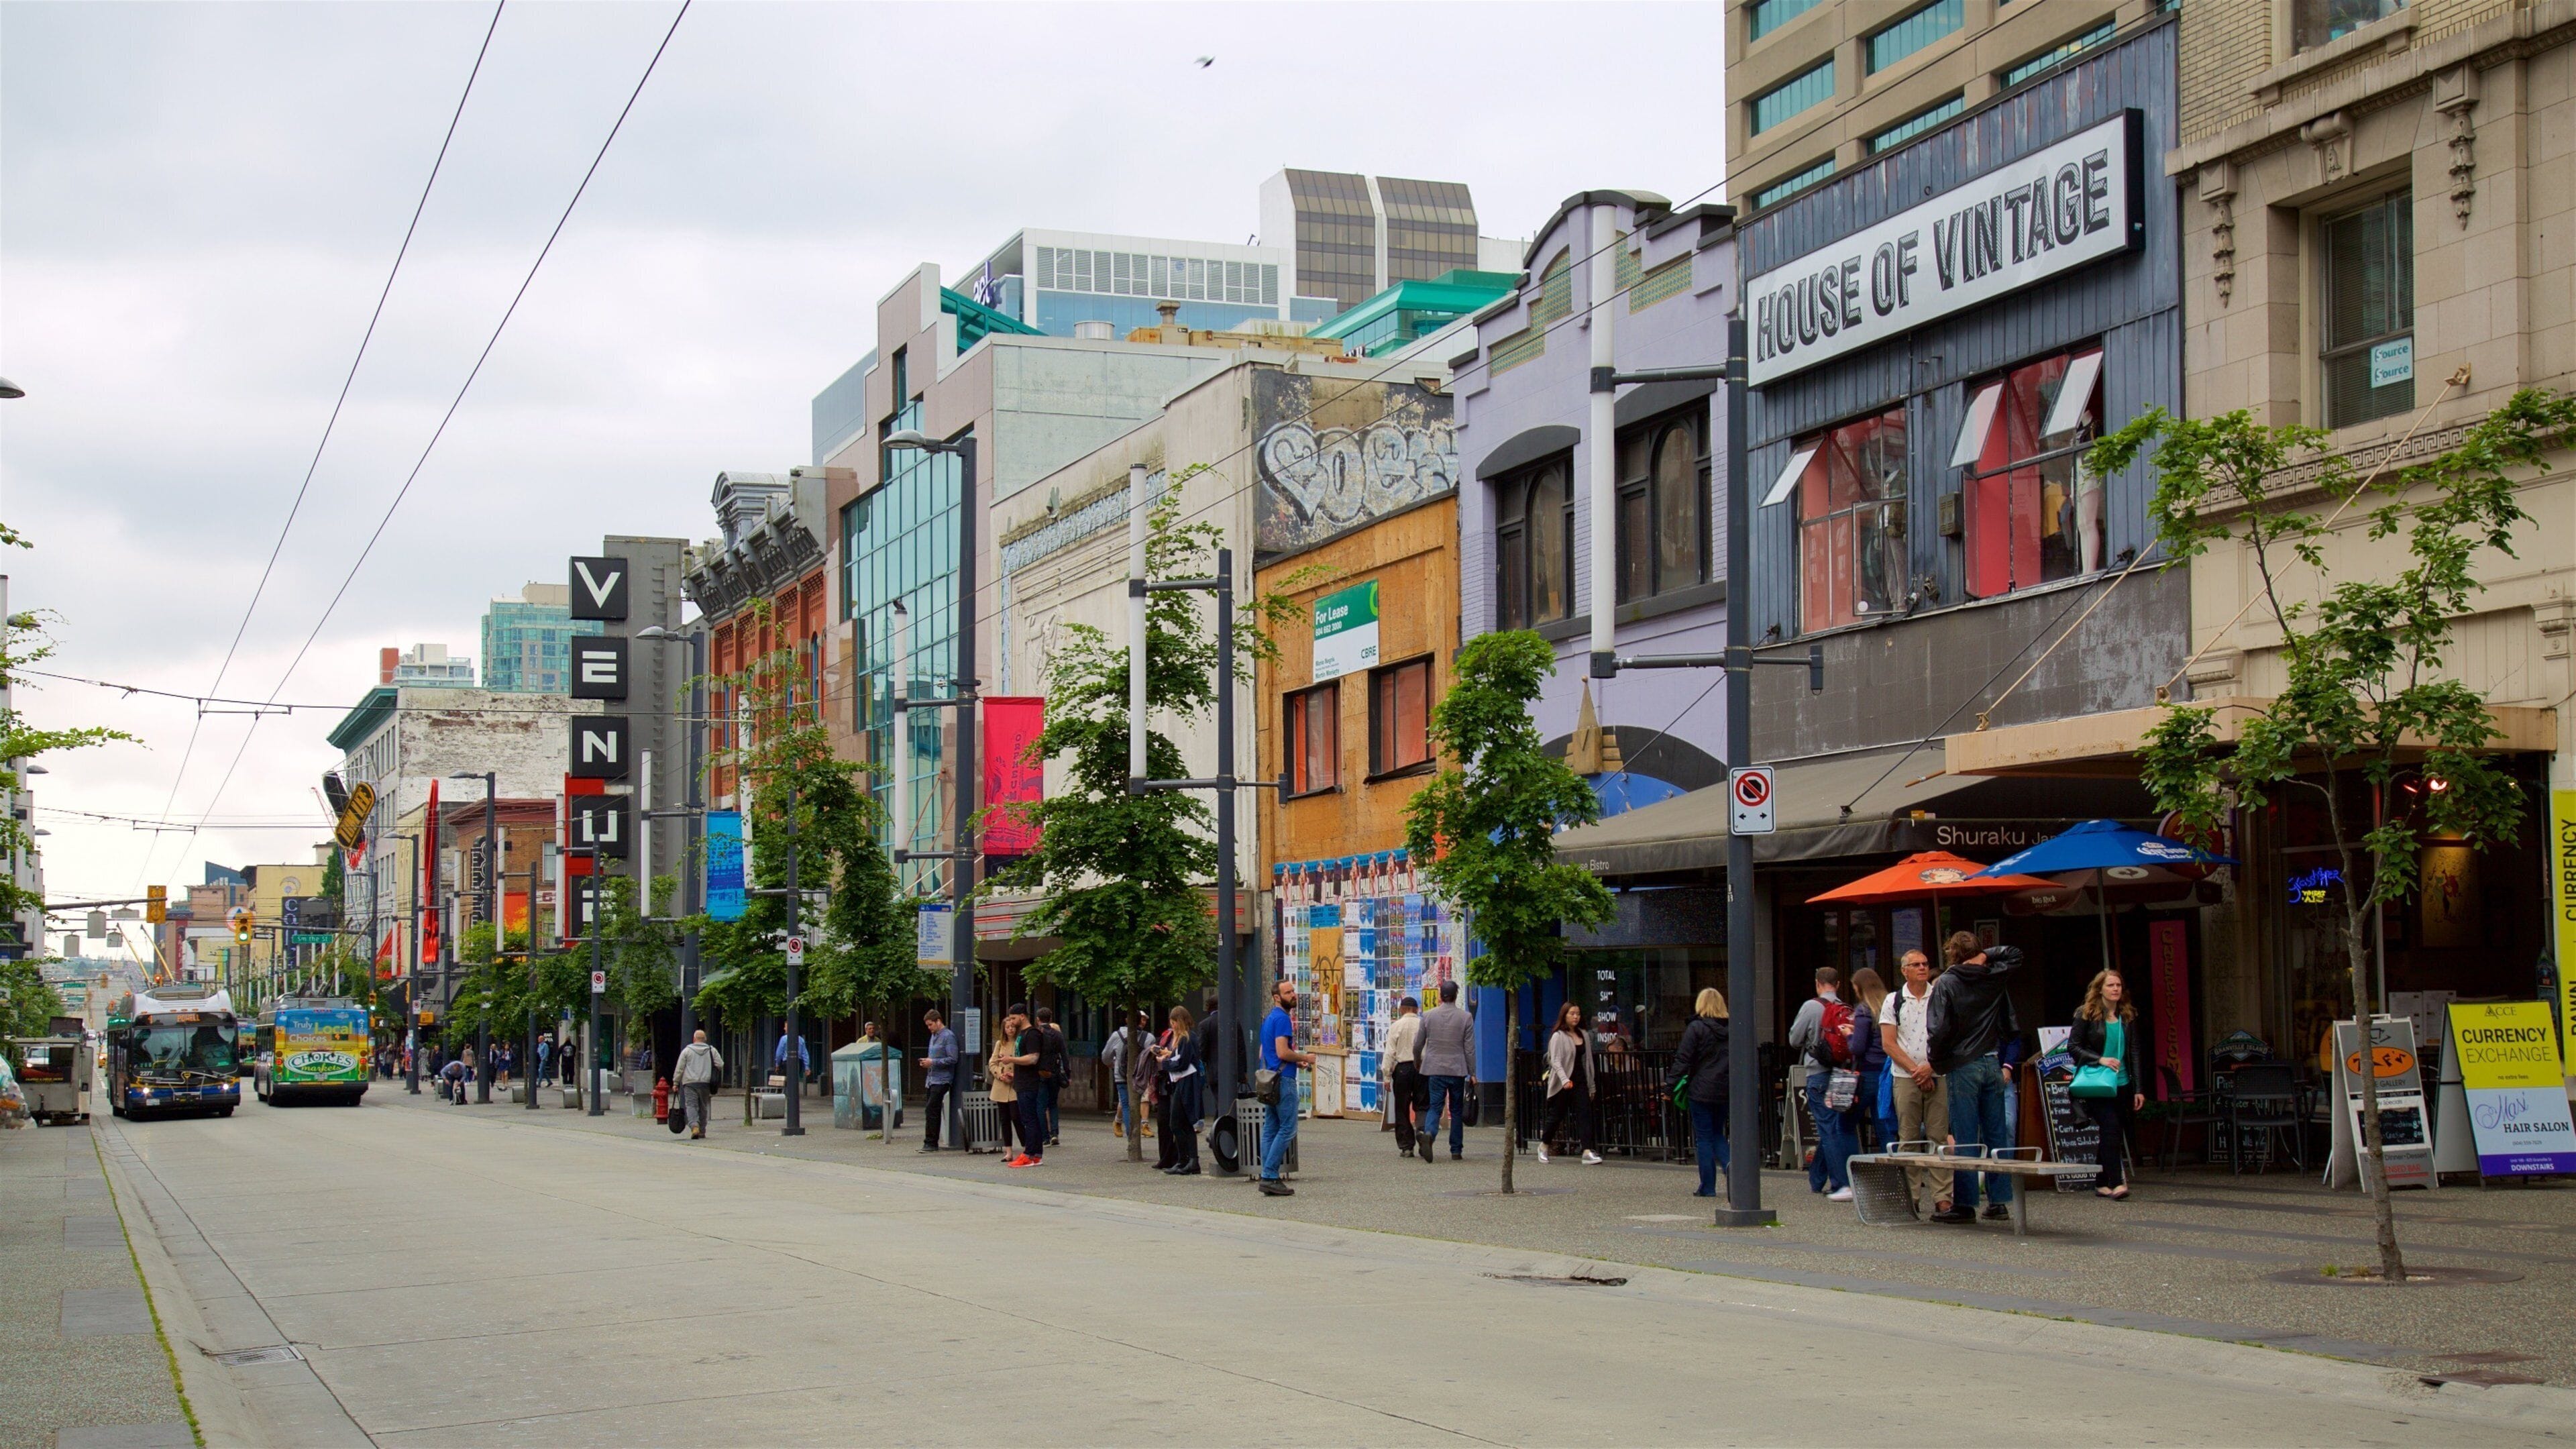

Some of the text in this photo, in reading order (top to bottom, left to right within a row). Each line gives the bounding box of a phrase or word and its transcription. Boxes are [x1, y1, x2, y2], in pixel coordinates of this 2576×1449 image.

[1757, 148, 2110, 363] HOUSE OF VINTAGE
[1316, 604, 1348, 625] For Lease
[1332, 621, 1342, 631] 3000
[1361, 646, 1377, 659] CBRE
[574, 561, 621, 922] VENUE
[1006, 733, 1022, 800] ORPHEUM
[1937, 826, 2026, 847] Shuraku
[1590, 859, 1609, 871] Bistro
[1597, 970, 1616, 981] TOTAL
[176, 1014, 201, 1022] POWELL
[1597, 1012, 1617, 1022] SHOW
[293, 1020, 313, 1029] Truly
[315, 1022, 353, 1034] Local
[289, 1034, 327, 1042] Choices
[2462, 1028, 2546, 1044] CURRENCY
[2246, 1044, 2268, 1055] ISLAND
[2466, 1046, 2552, 1063] EXCHANGE
[291, 1053, 352, 1067] CHOICES
[2043, 1054, 2072, 1068] GRANVILL
[302, 1063, 341, 1073] markets
[2379, 1079, 2406, 1087] GALLERY
[2504, 1122, 2569, 1133] HAIR SALON
[2511, 1163, 2554, 1171] DOWNSTAIRS
